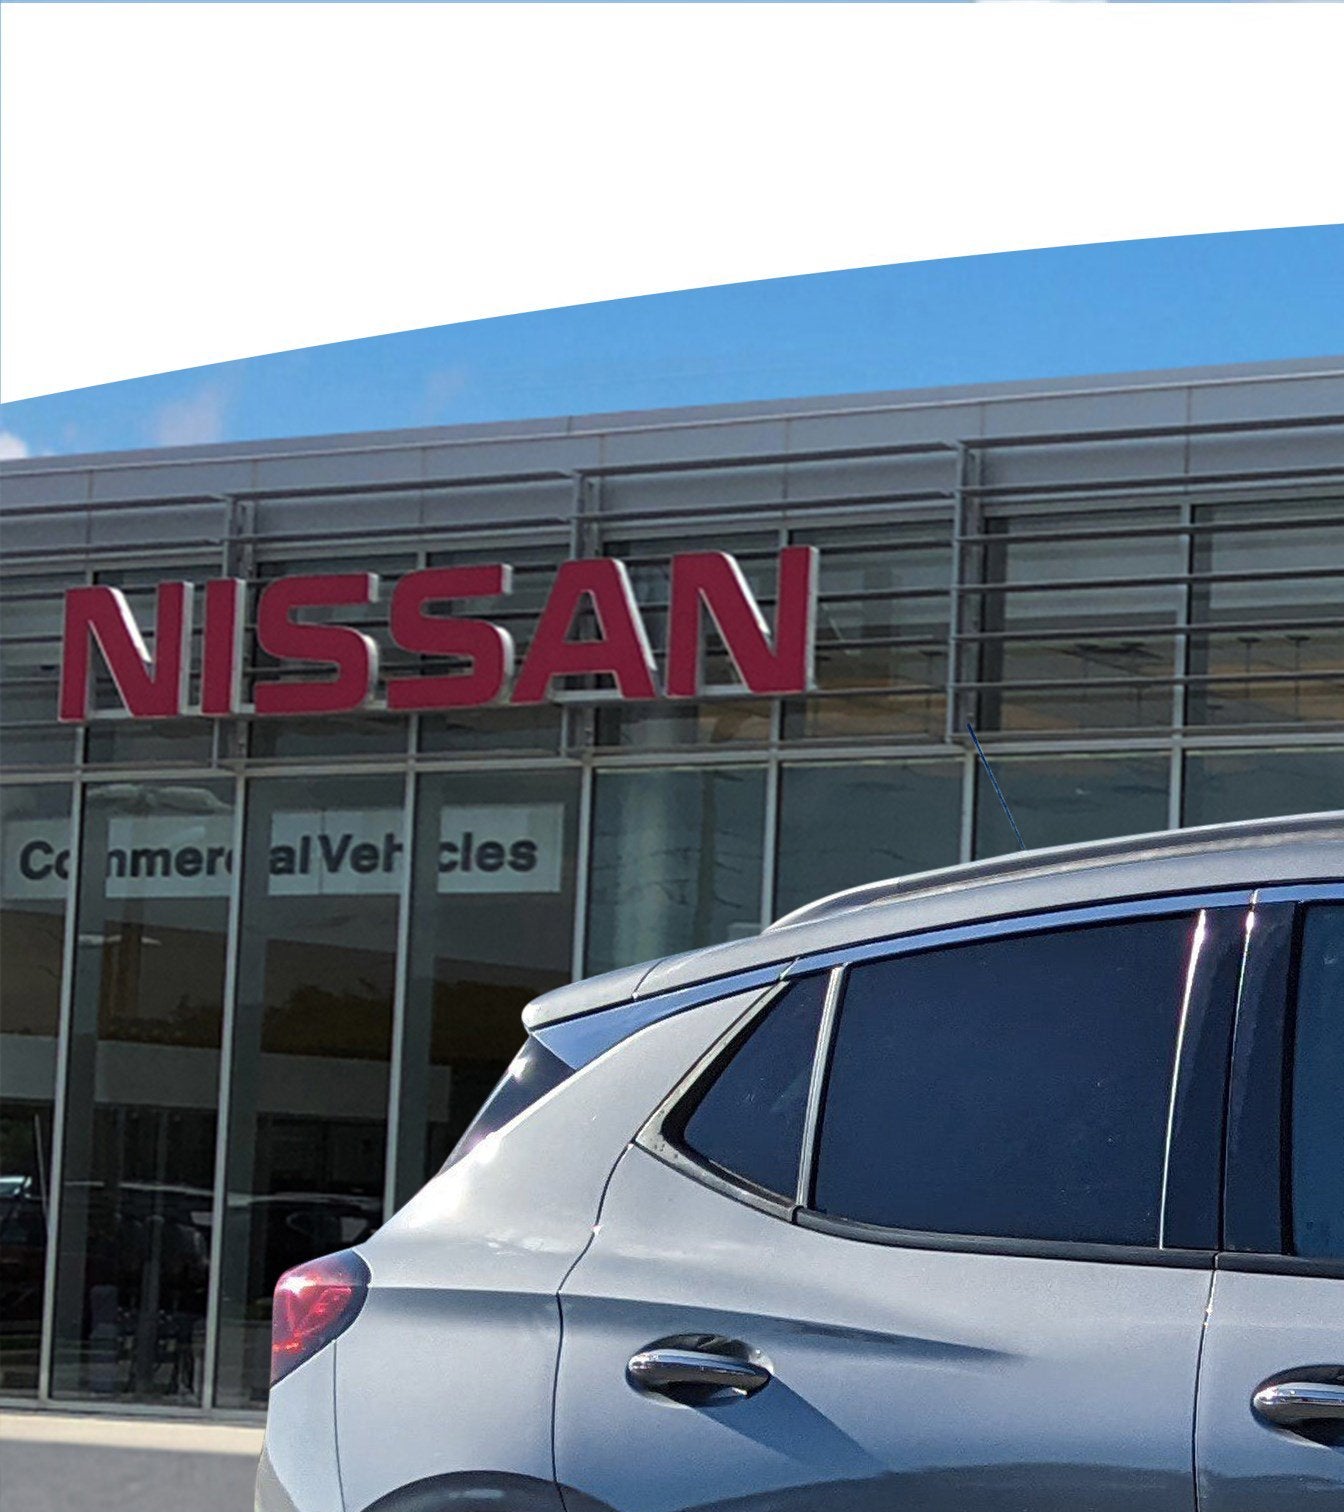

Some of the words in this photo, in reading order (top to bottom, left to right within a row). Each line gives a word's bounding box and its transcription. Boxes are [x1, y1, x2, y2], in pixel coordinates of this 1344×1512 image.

[57, 545, 819, 723] NISSAN
[19, 835, 311, 880] Cmeral
[318, 832, 539, 874] Vehcles
